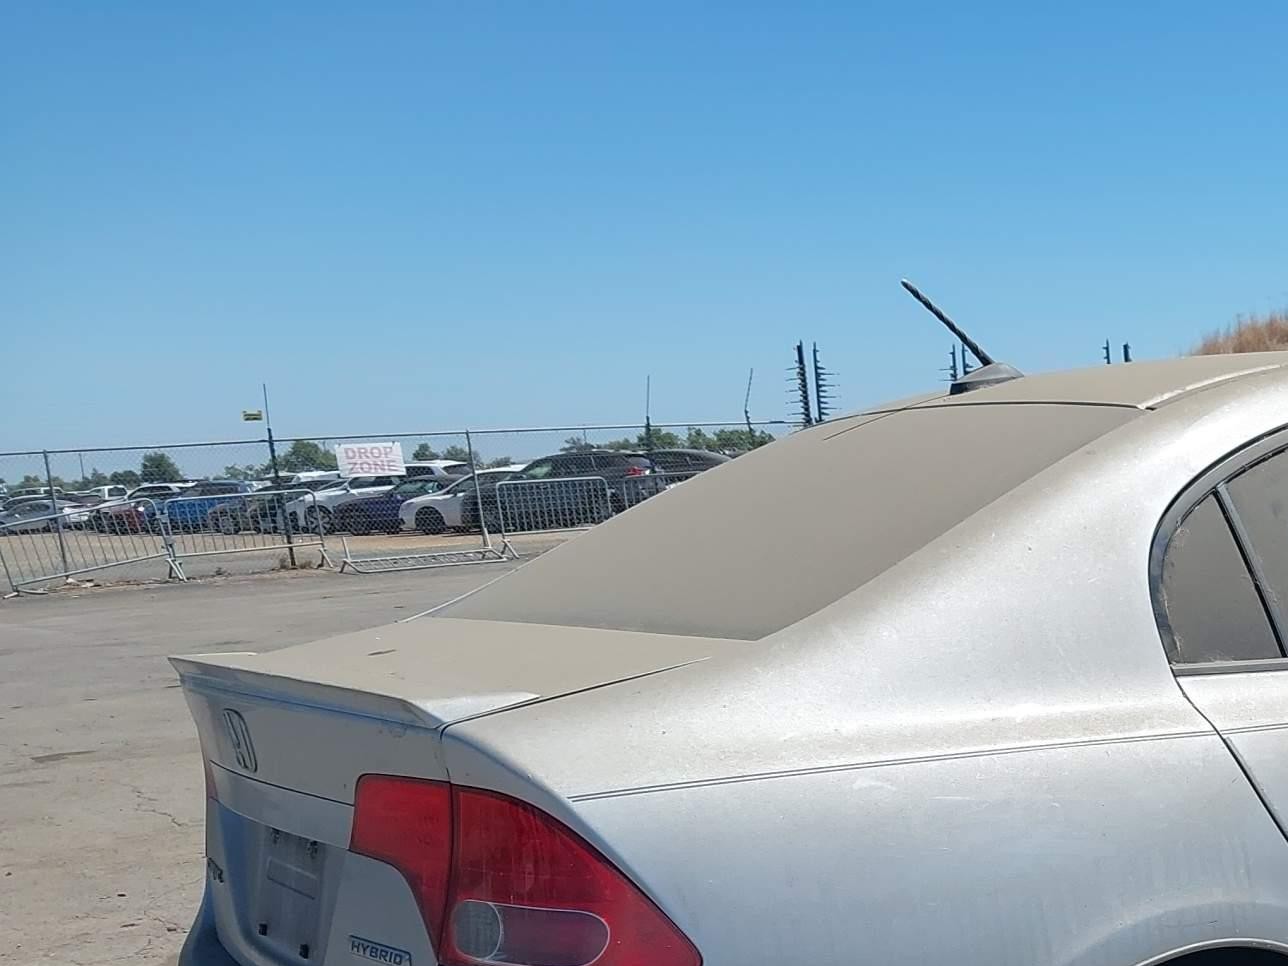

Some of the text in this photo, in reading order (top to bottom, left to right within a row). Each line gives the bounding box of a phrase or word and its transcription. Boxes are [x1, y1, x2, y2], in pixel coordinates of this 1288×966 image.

[344, 446, 393, 460] DROP
[347, 460, 400, 475] ZONE
[350, 940, 403, 966] HYBRID
